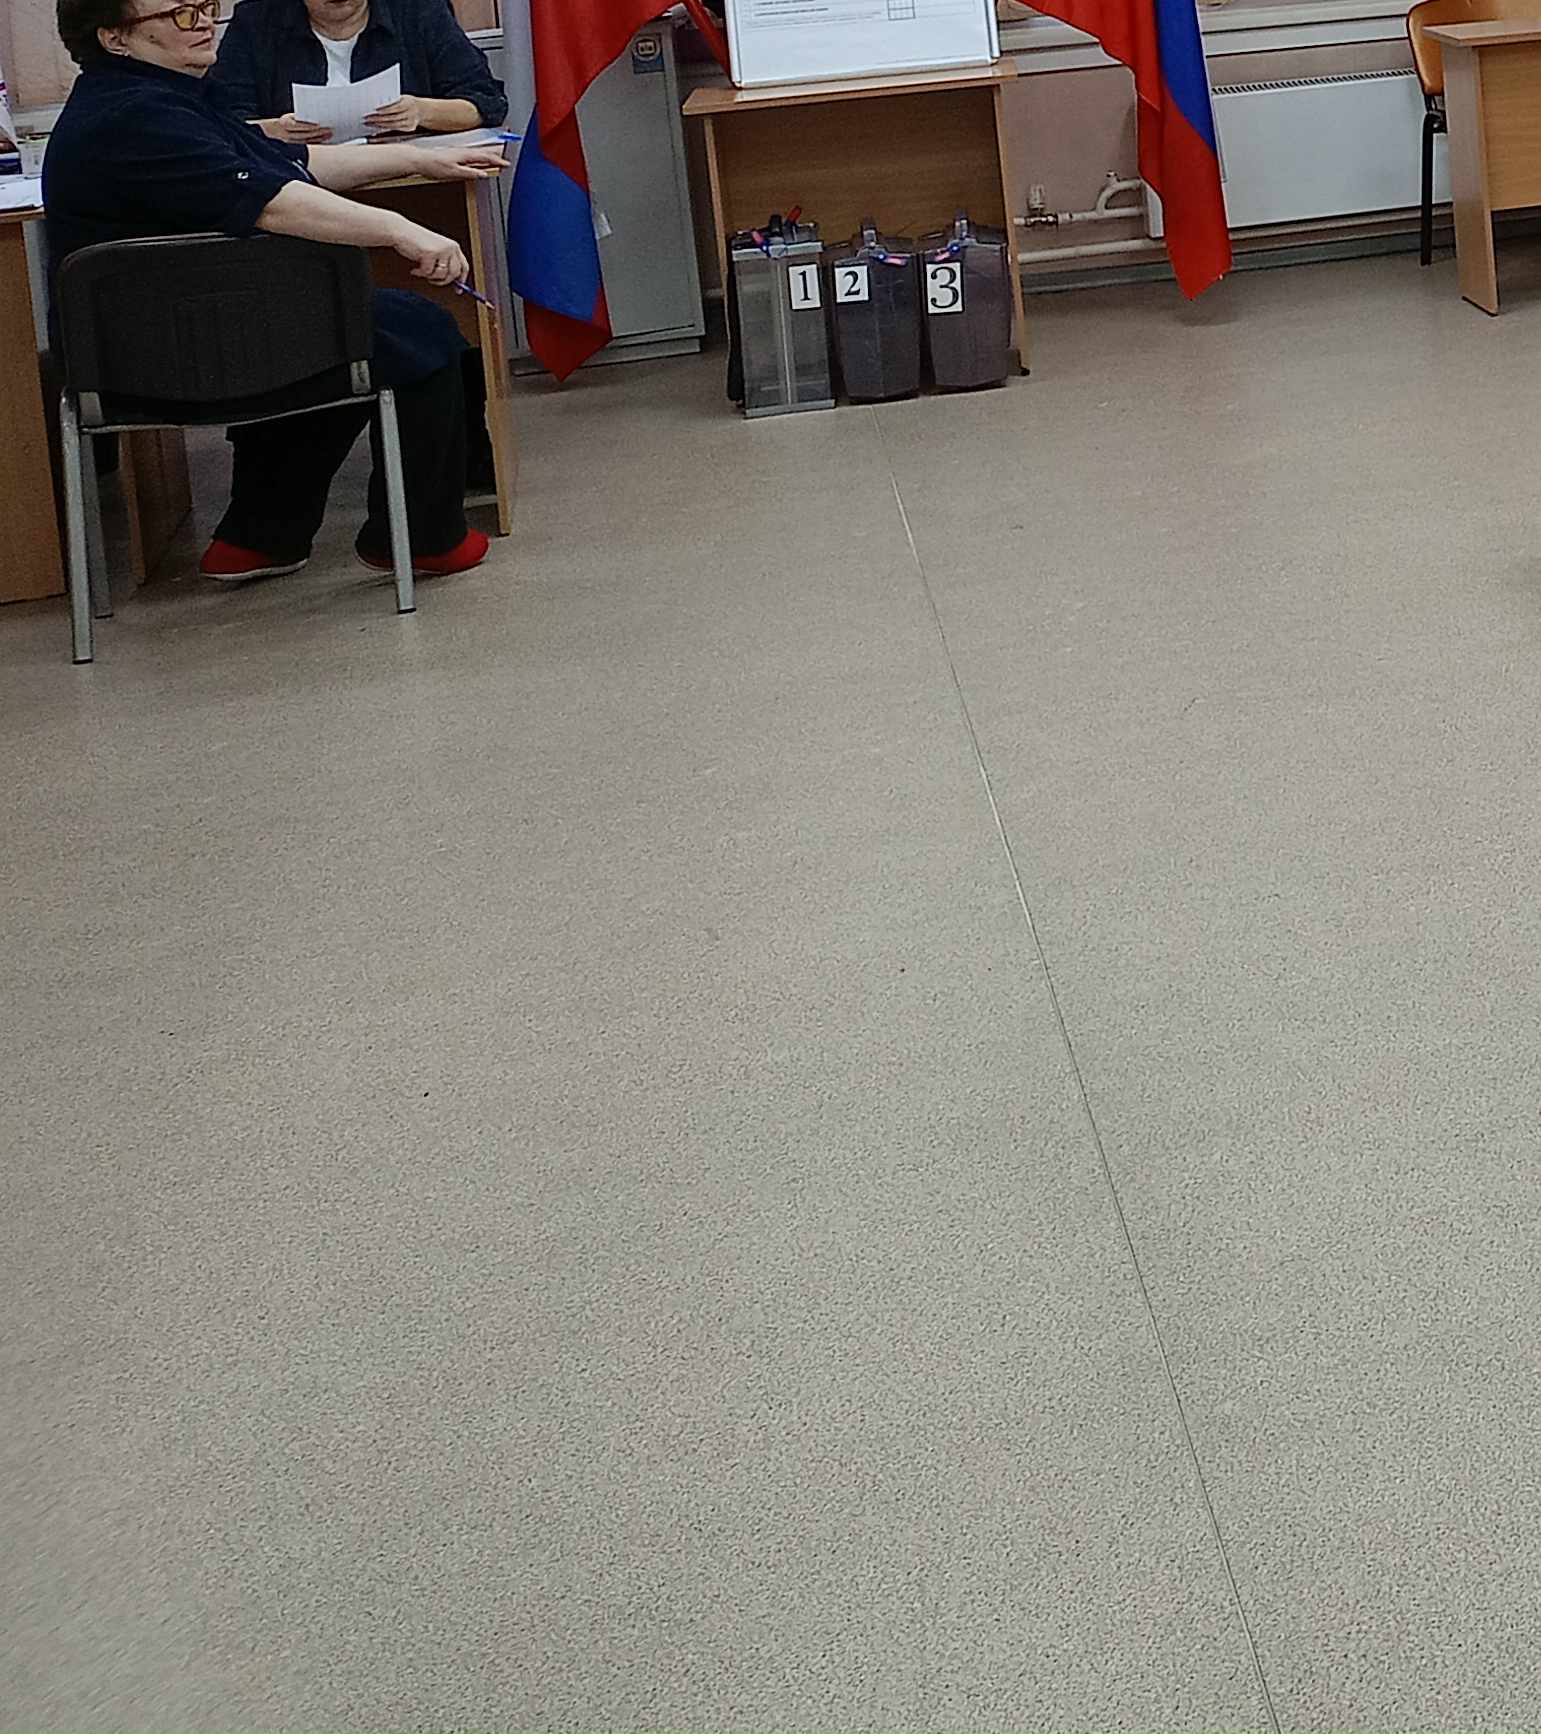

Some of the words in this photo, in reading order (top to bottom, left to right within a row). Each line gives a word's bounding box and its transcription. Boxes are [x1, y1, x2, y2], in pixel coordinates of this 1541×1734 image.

[797, 270, 812, 301] 1
[843, 270, 861, 297] 2
[930, 266, 959, 309] 3
